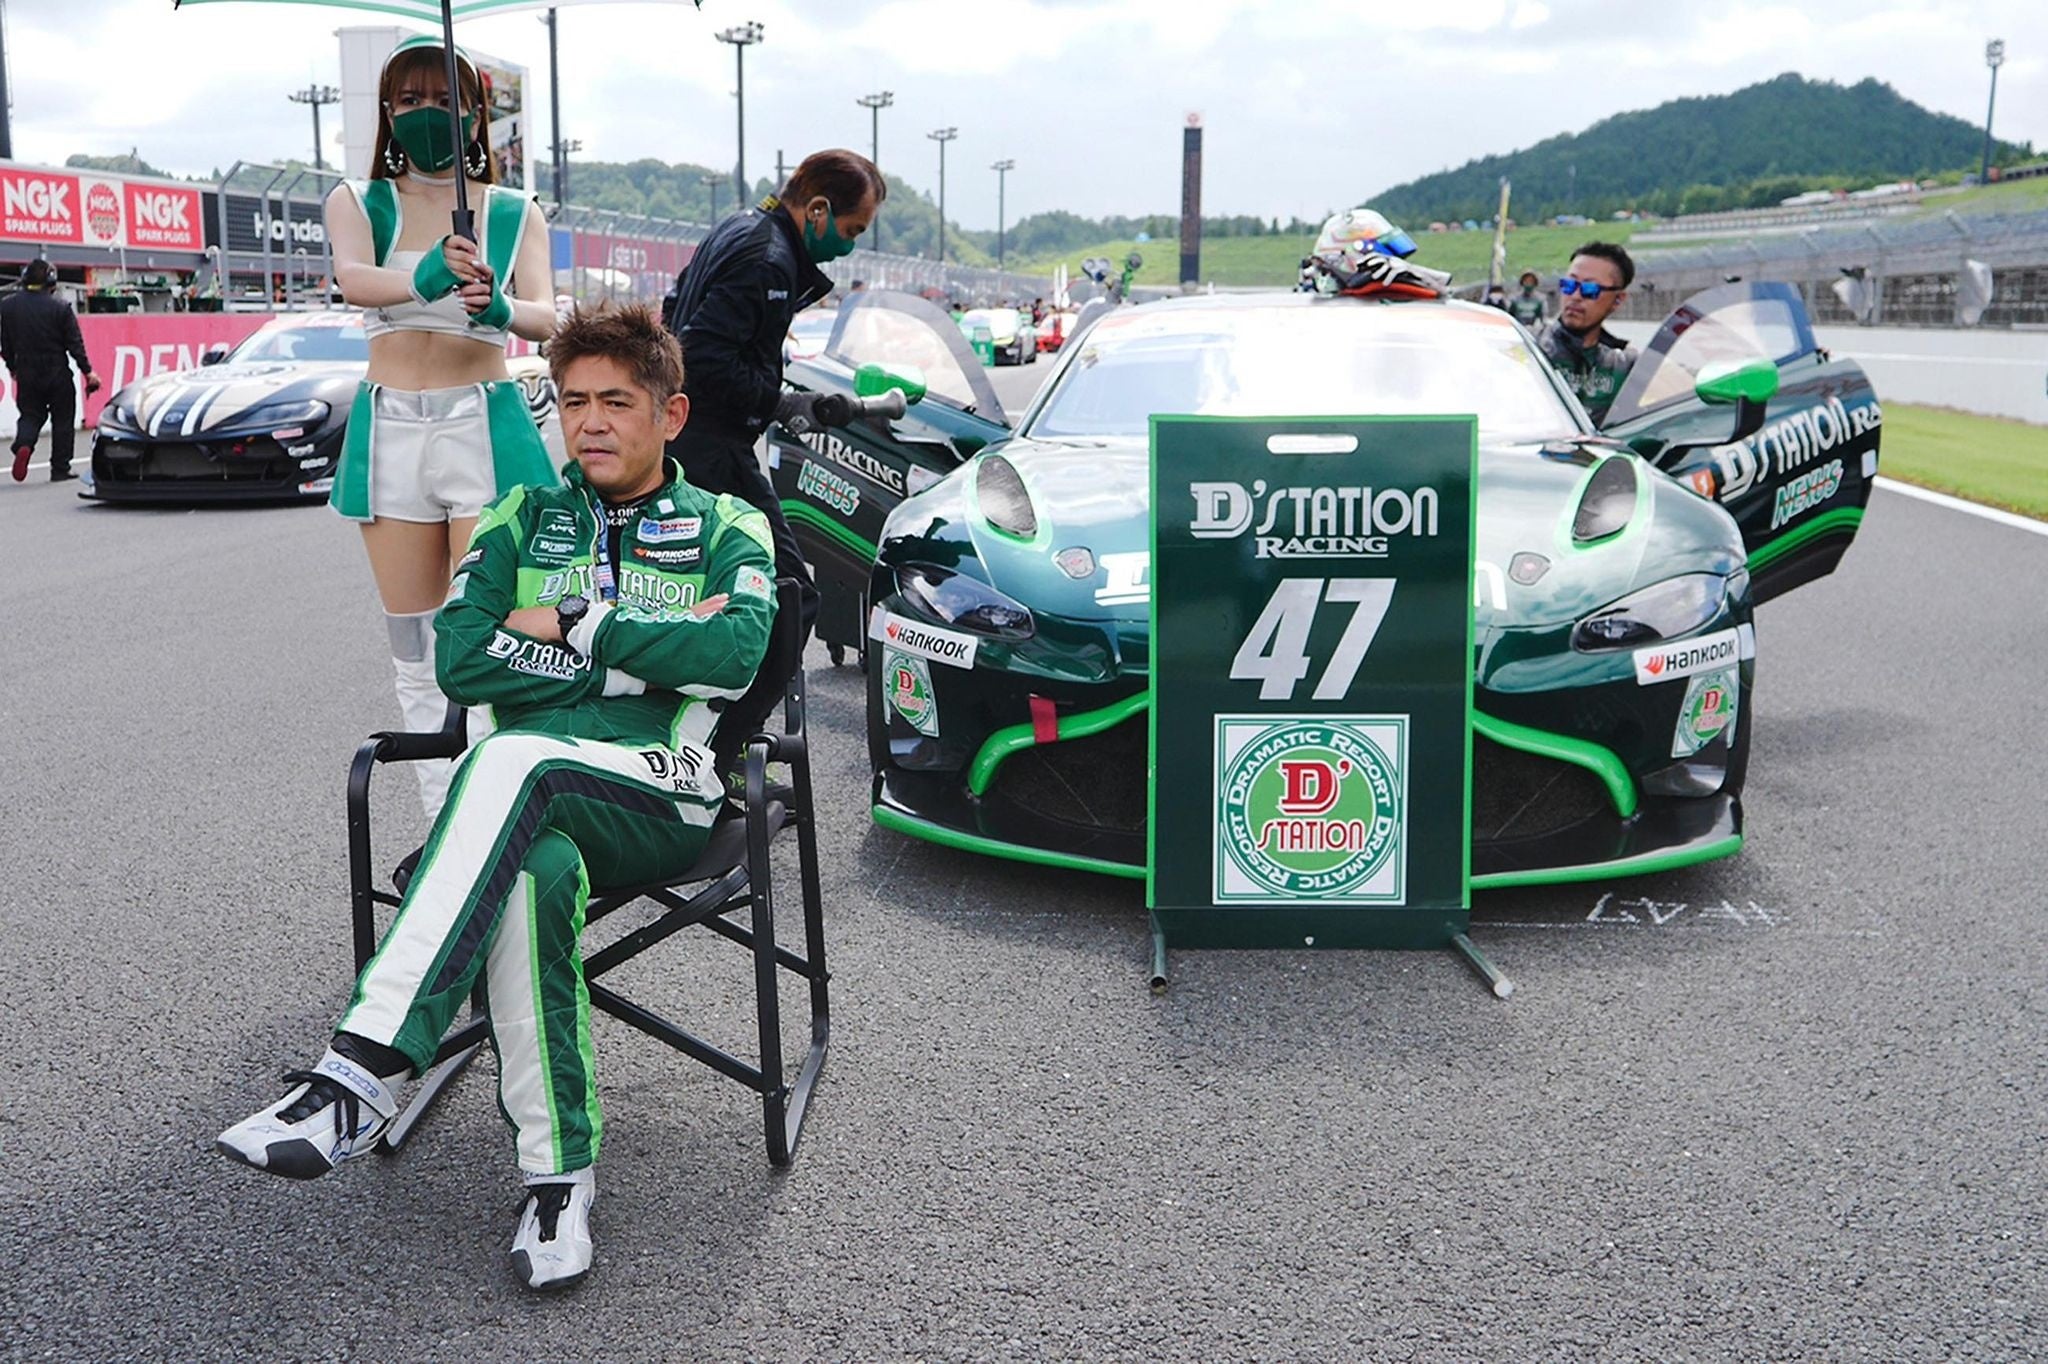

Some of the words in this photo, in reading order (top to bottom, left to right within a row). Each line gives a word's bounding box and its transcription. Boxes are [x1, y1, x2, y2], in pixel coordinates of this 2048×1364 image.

[3, 177, 71, 220] NGK
[134, 191, 190, 230] NGK
[5, 218, 38, 233] SPARK
[40, 221, 72, 236] PLUGS
[136, 228, 163, 243] SPARK
[164, 231, 191, 244] PLUGS
[254, 211, 324, 242] Honda
[826, 434, 904, 497] RACING
[797, 459, 860, 516] NEXUS
[1255, 537, 1389, 558] RACING
[1229, 577, 1397, 700] 47
[509, 657, 574, 678] RACING
[1229, 731, 1322, 806] DRAMATIC
[1330, 733, 1391, 808] RESORT
[1231, 812, 1290, 887] RESORT
[1257, 820, 1364, 850] STATION
[1298, 815, 1392, 888] DRAMATIC
